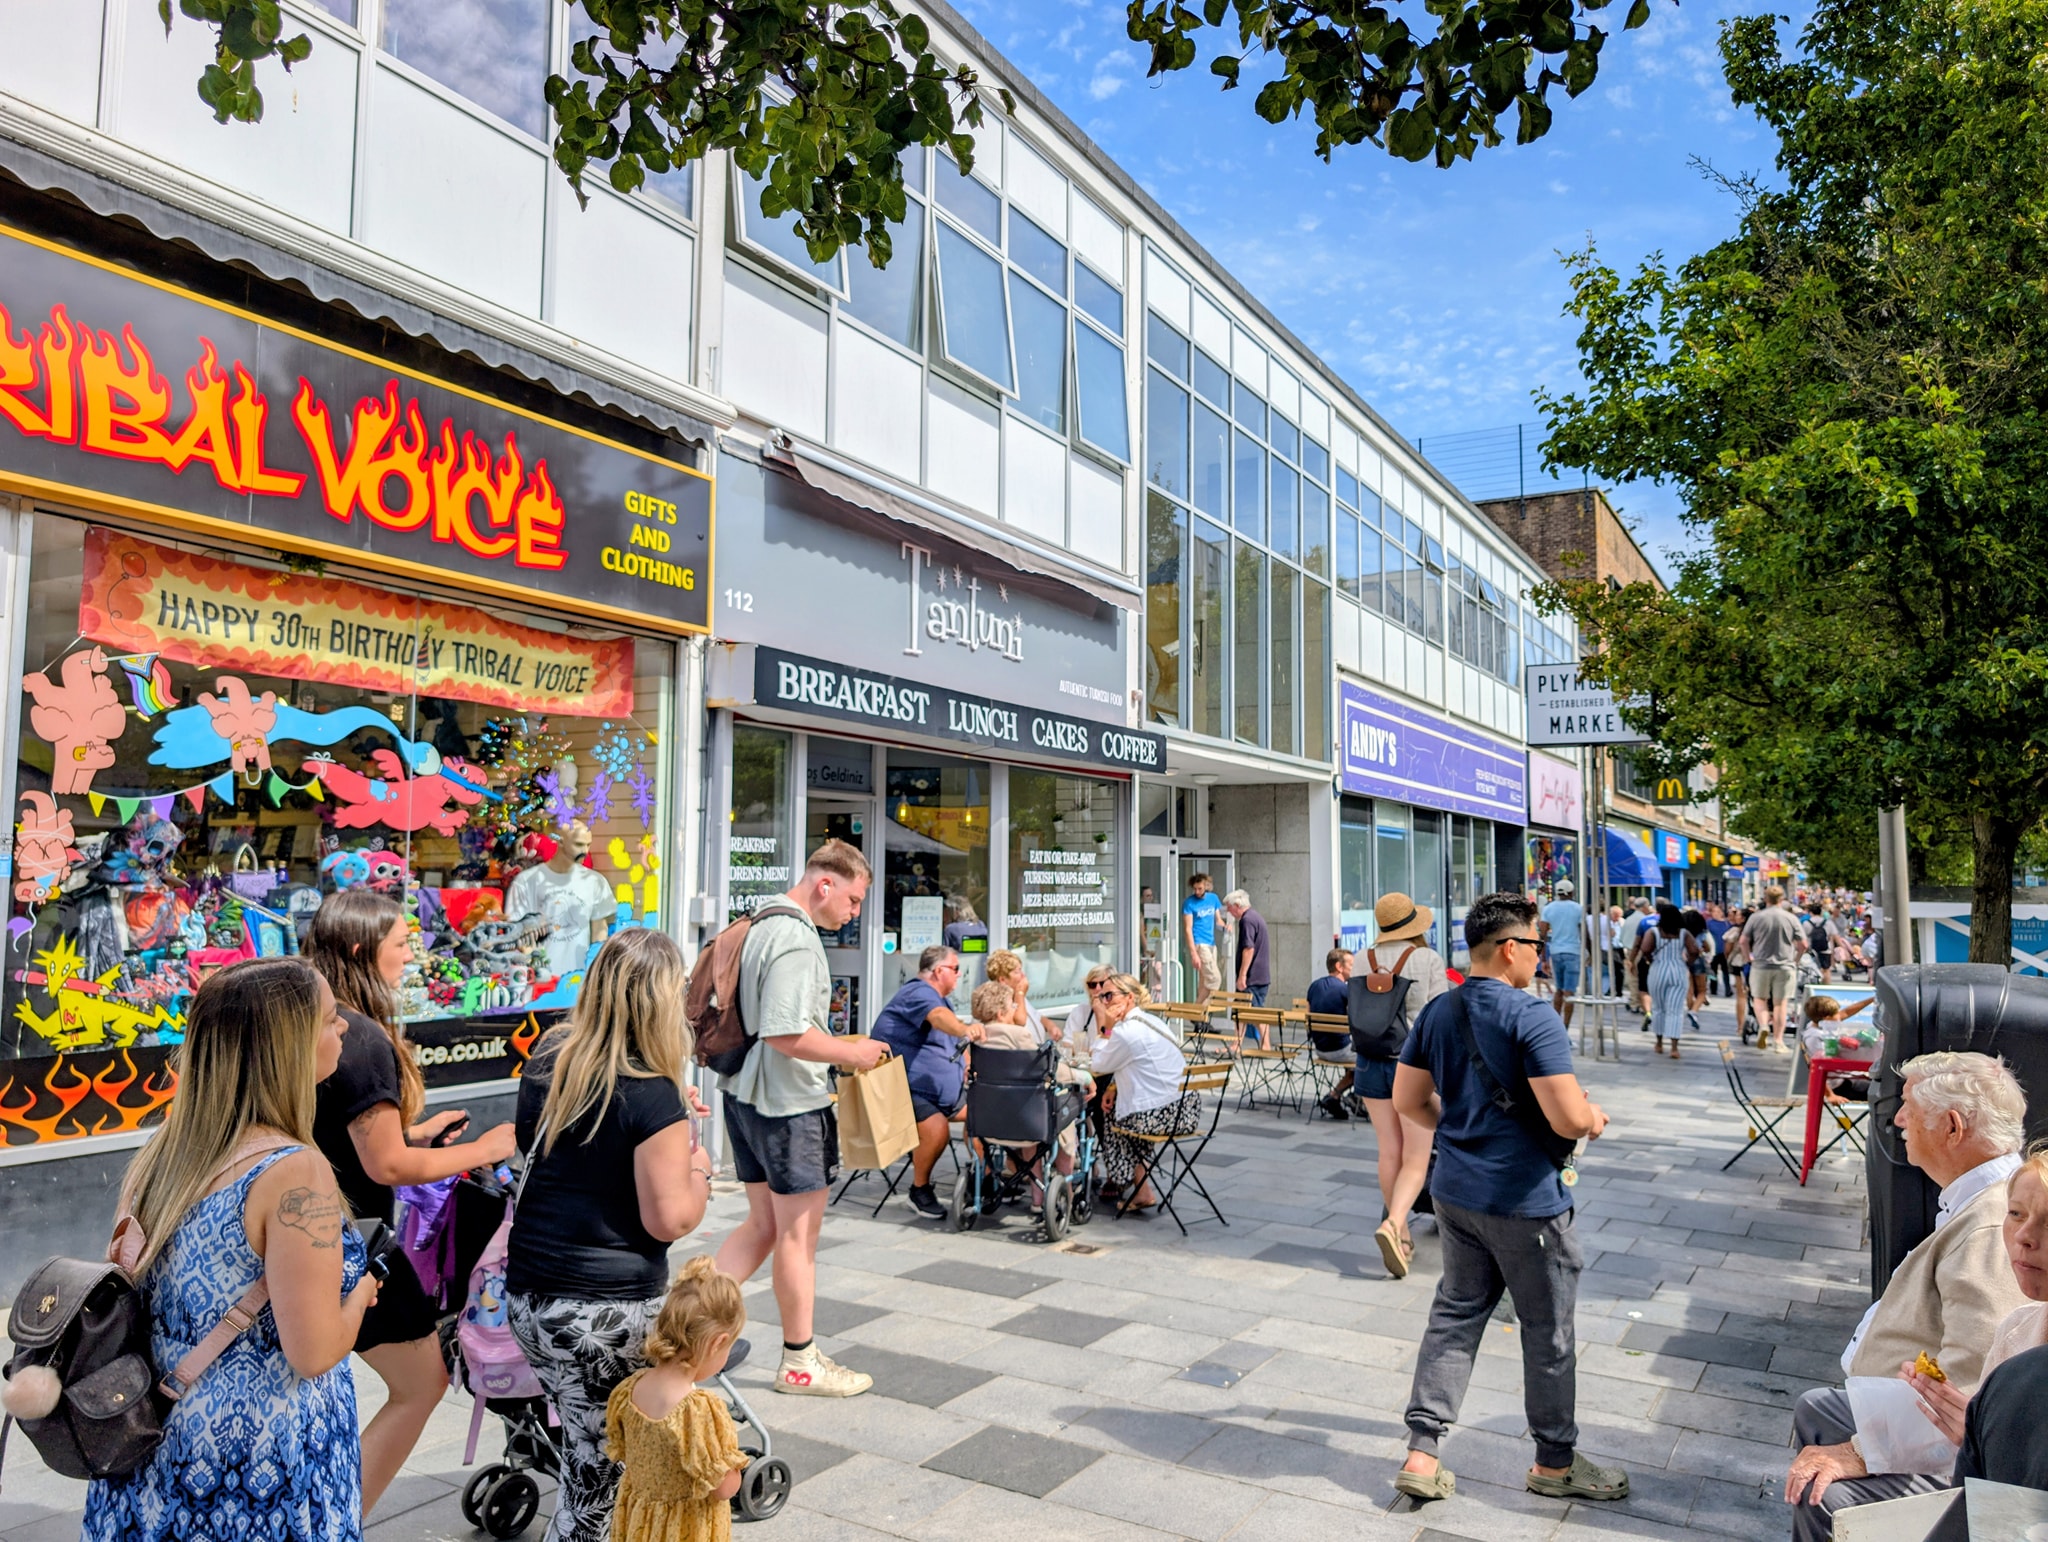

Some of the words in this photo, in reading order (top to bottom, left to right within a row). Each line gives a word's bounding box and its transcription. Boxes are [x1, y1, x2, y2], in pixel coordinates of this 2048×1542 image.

[291, 375, 569, 570] VOICE
[624, 489, 678, 525] GIFTS
[629, 524, 671, 553] AND
[601, 547, 695, 591] CLOTHING
[725, 588, 753, 613] 112
[902, 541, 1024, 661] Tantuni
[158, 590, 260, 643] HAPPY
[452, 641, 524, 686] TRIBAL
[535, 661, 591, 694] VOICE
[1538, 674, 1610, 693] PLYMO
[1110, 692, 1123, 707] FOOD
[1550, 698, 1604, 709] ESTABLISHED
[777, 660, 930, 725] BREAKFAST
[948, 698, 1019, 741] LUNCH
[1032, 717, 1088, 754] CAKES
[1101, 730, 1158, 766] COFFEE
[1351, 719, 1397, 768] ANDY'S
[807, 768, 818, 784] oş
[821, 765, 864, 785] Geldiniz
[730, 836, 777, 853] REAKFAST
[1029, 850, 1043, 864] EAT
[1043, 850, 1051, 864] IN
[1051, 851, 1062, 865] OR
[729, 866, 762, 881] DREN'S
[763, 866, 789, 881] MENU
[1024, 871, 1054, 884] TURKISH
[1055, 871, 1077, 884] WRAPS
[1084, 872, 1101, 884] GRILL
[1022, 893, 1042, 907] MEZE
[1043, 893, 1071, 907] SHARING
[1072, 893, 1103, 906] PLATTERS
[1007, 913, 1048, 928] HOMEMADE
[1049, 912, 1082, 927] DESSERTS
[1089, 911, 1115, 925] BAKLAVA
[414, 1036, 508, 1067] ice.co.uk
